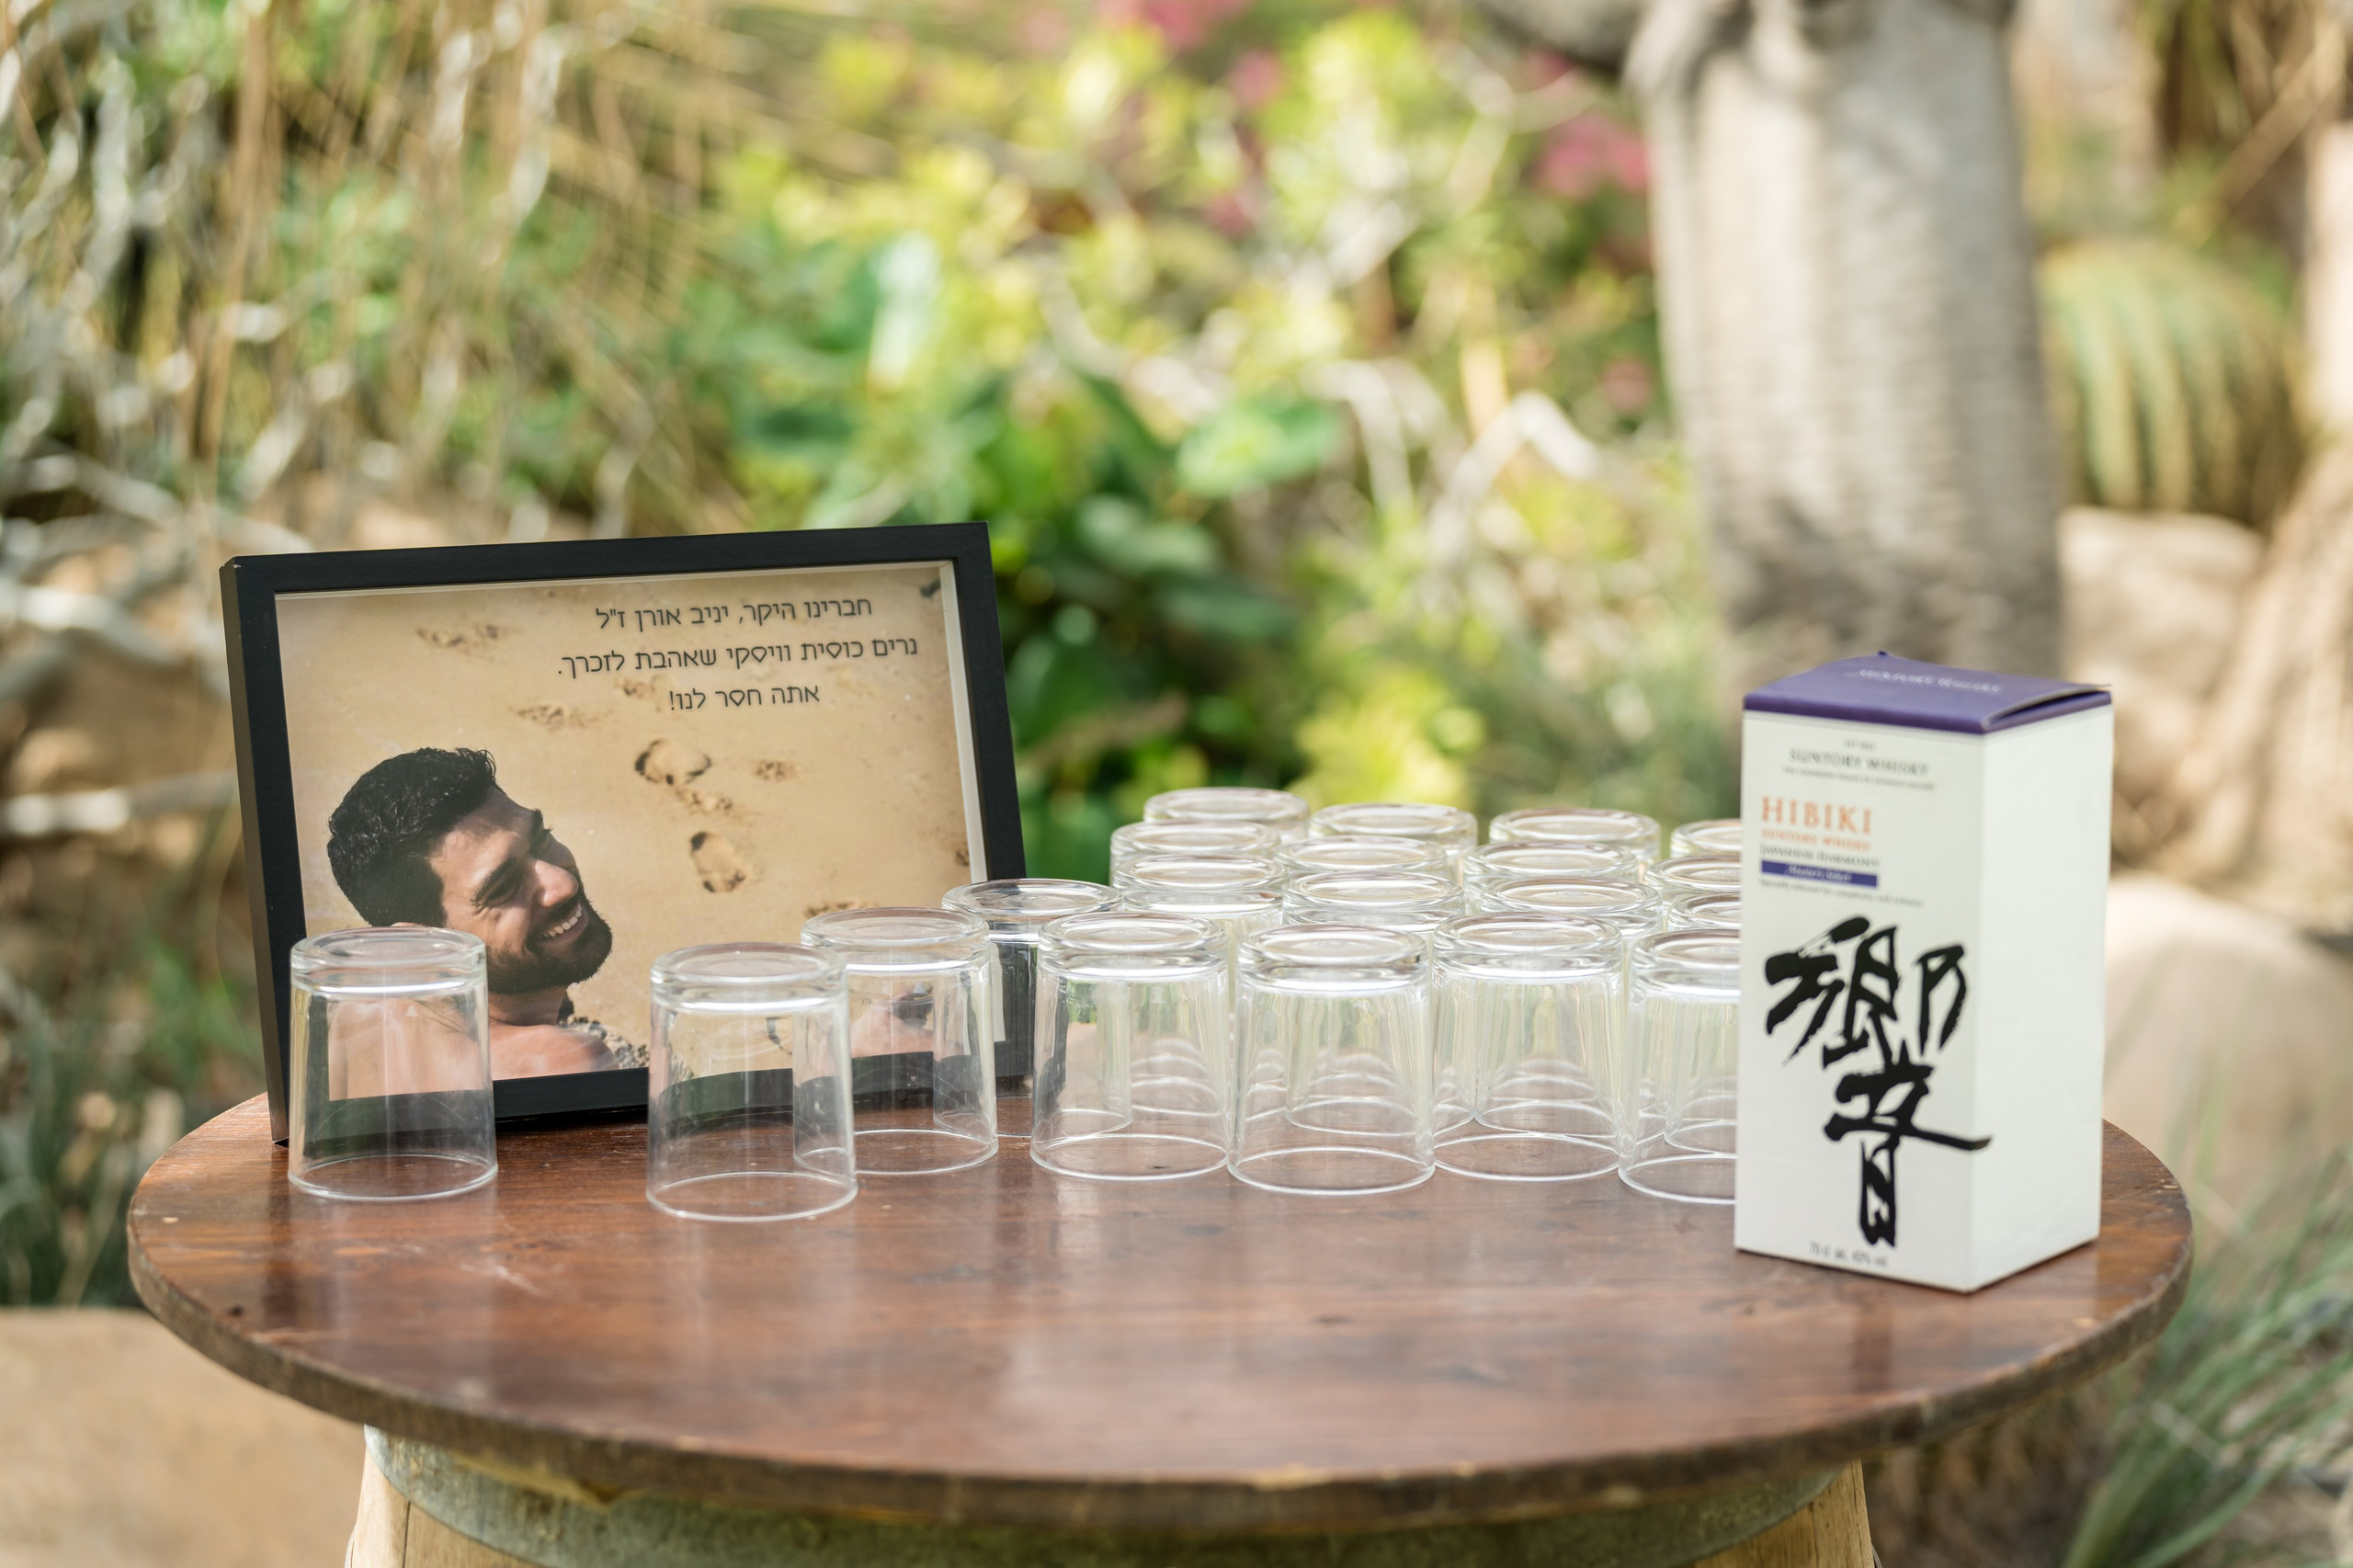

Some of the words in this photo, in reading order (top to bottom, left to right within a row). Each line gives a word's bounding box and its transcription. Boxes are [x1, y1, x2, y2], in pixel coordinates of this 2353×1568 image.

[689, 605, 729, 624] יניב
[739, 602, 797, 627] היקר,
[803, 598, 872, 619] חברינו
[634, 608, 682, 633] אורן
[634, 648, 717, 670] שאהבת
[725, 645, 791, 670] וויסקי
[801, 641, 864, 661] כוסית
[871, 638, 918, 657] נרים
[557, 649, 626, 680] לזכרך.
[669, 687, 707, 711] לנו!
[714, 688, 763, 708] חסר
[771, 685, 821, 705] אתה
[1790, 747, 1861, 767] SUNTORY
[1866, 756, 1930, 777] WHISKY
[1761, 795, 1873, 835] HIBIKI
